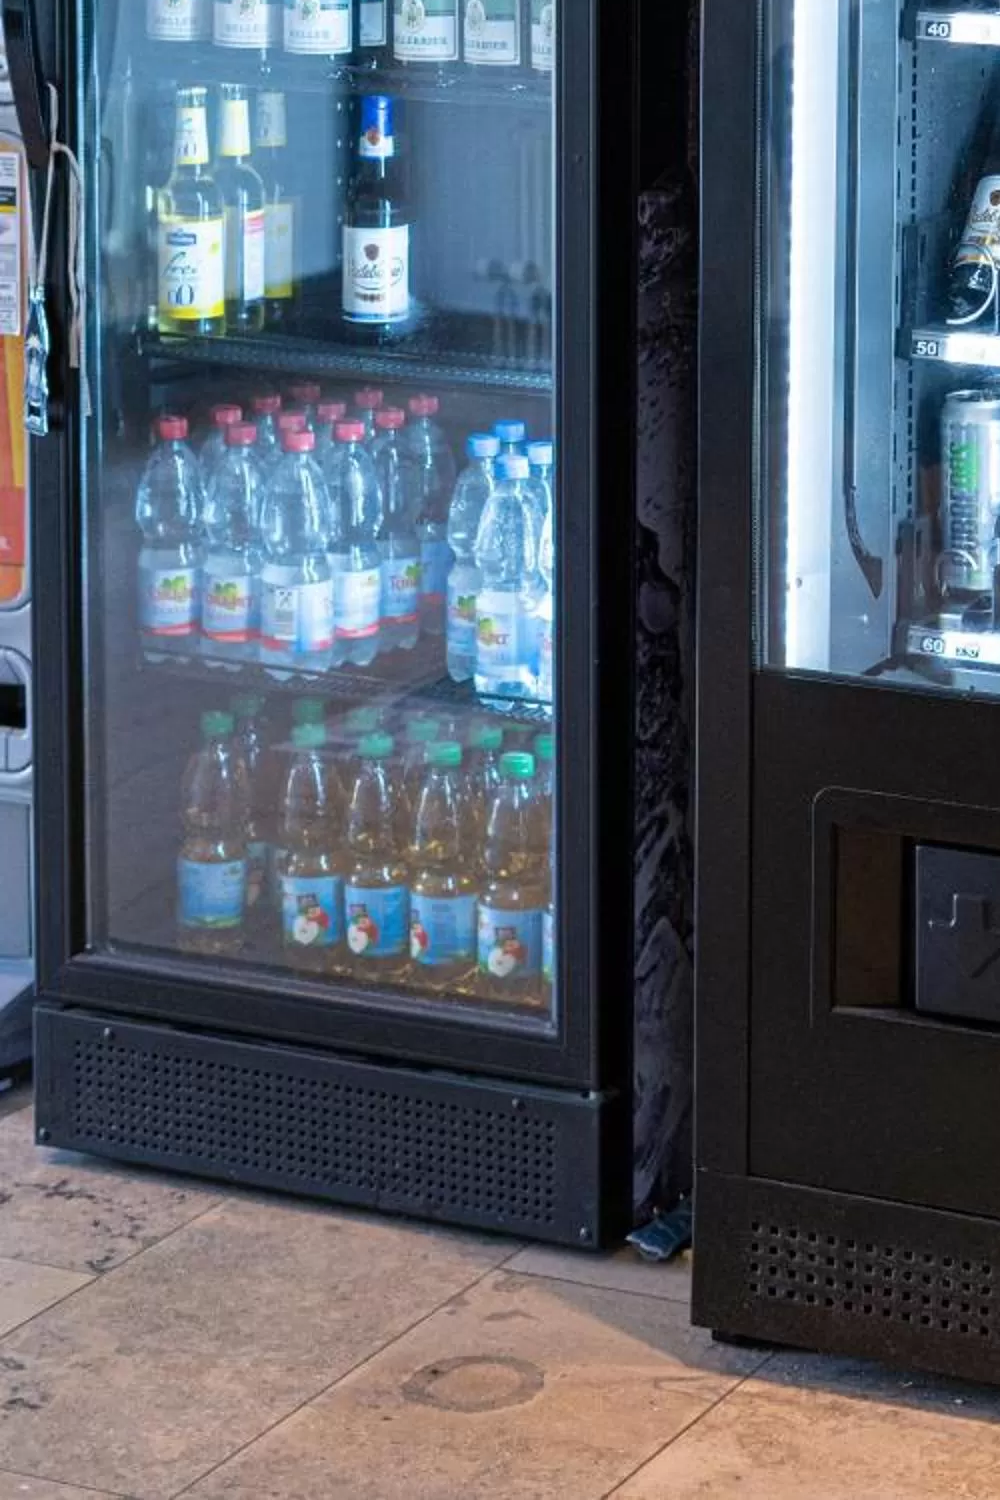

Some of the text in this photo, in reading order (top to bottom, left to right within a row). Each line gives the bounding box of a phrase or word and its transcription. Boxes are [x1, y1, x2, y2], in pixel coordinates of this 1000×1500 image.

[926, 21, 950, 37] 40
[915, 341, 938, 356] 50
[921, 637, 945, 653] 60
